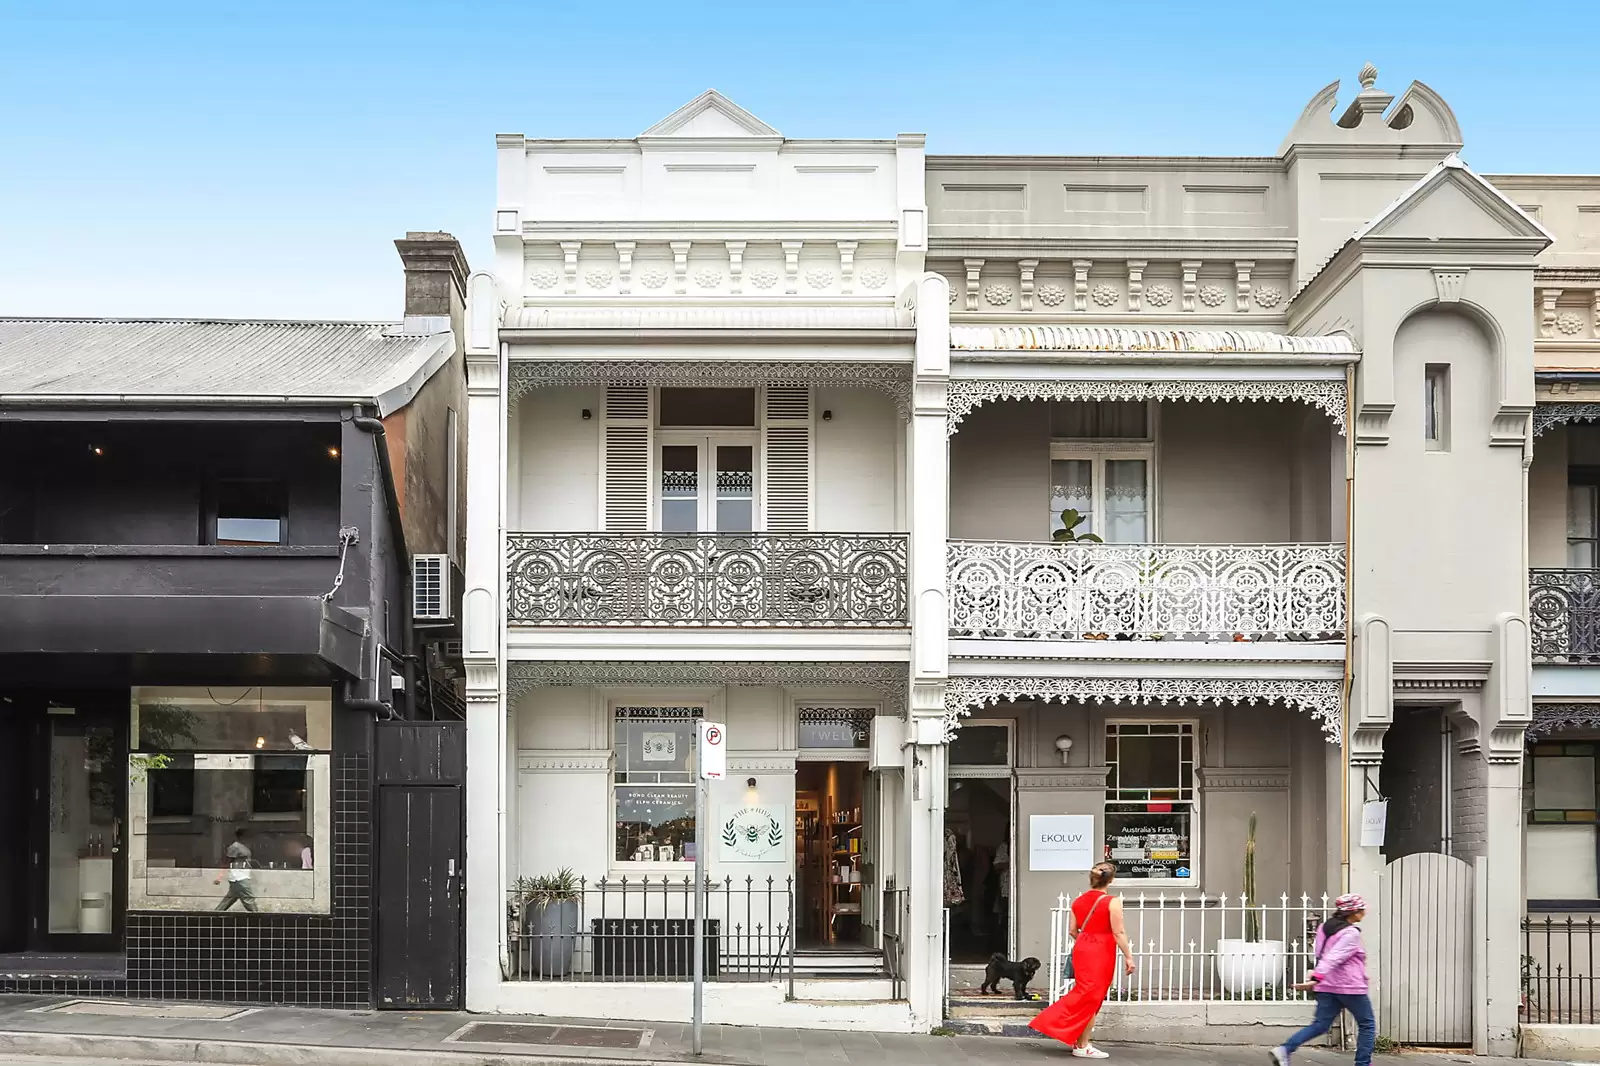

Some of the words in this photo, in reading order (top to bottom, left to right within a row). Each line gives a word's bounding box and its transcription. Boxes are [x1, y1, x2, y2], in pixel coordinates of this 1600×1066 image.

[811, 731, 866, 741] TWELVE
[734, 808, 748, 819] THE
[755, 807, 771, 819] HIVE
[1041, 833, 1083, 843] EKOLUV
